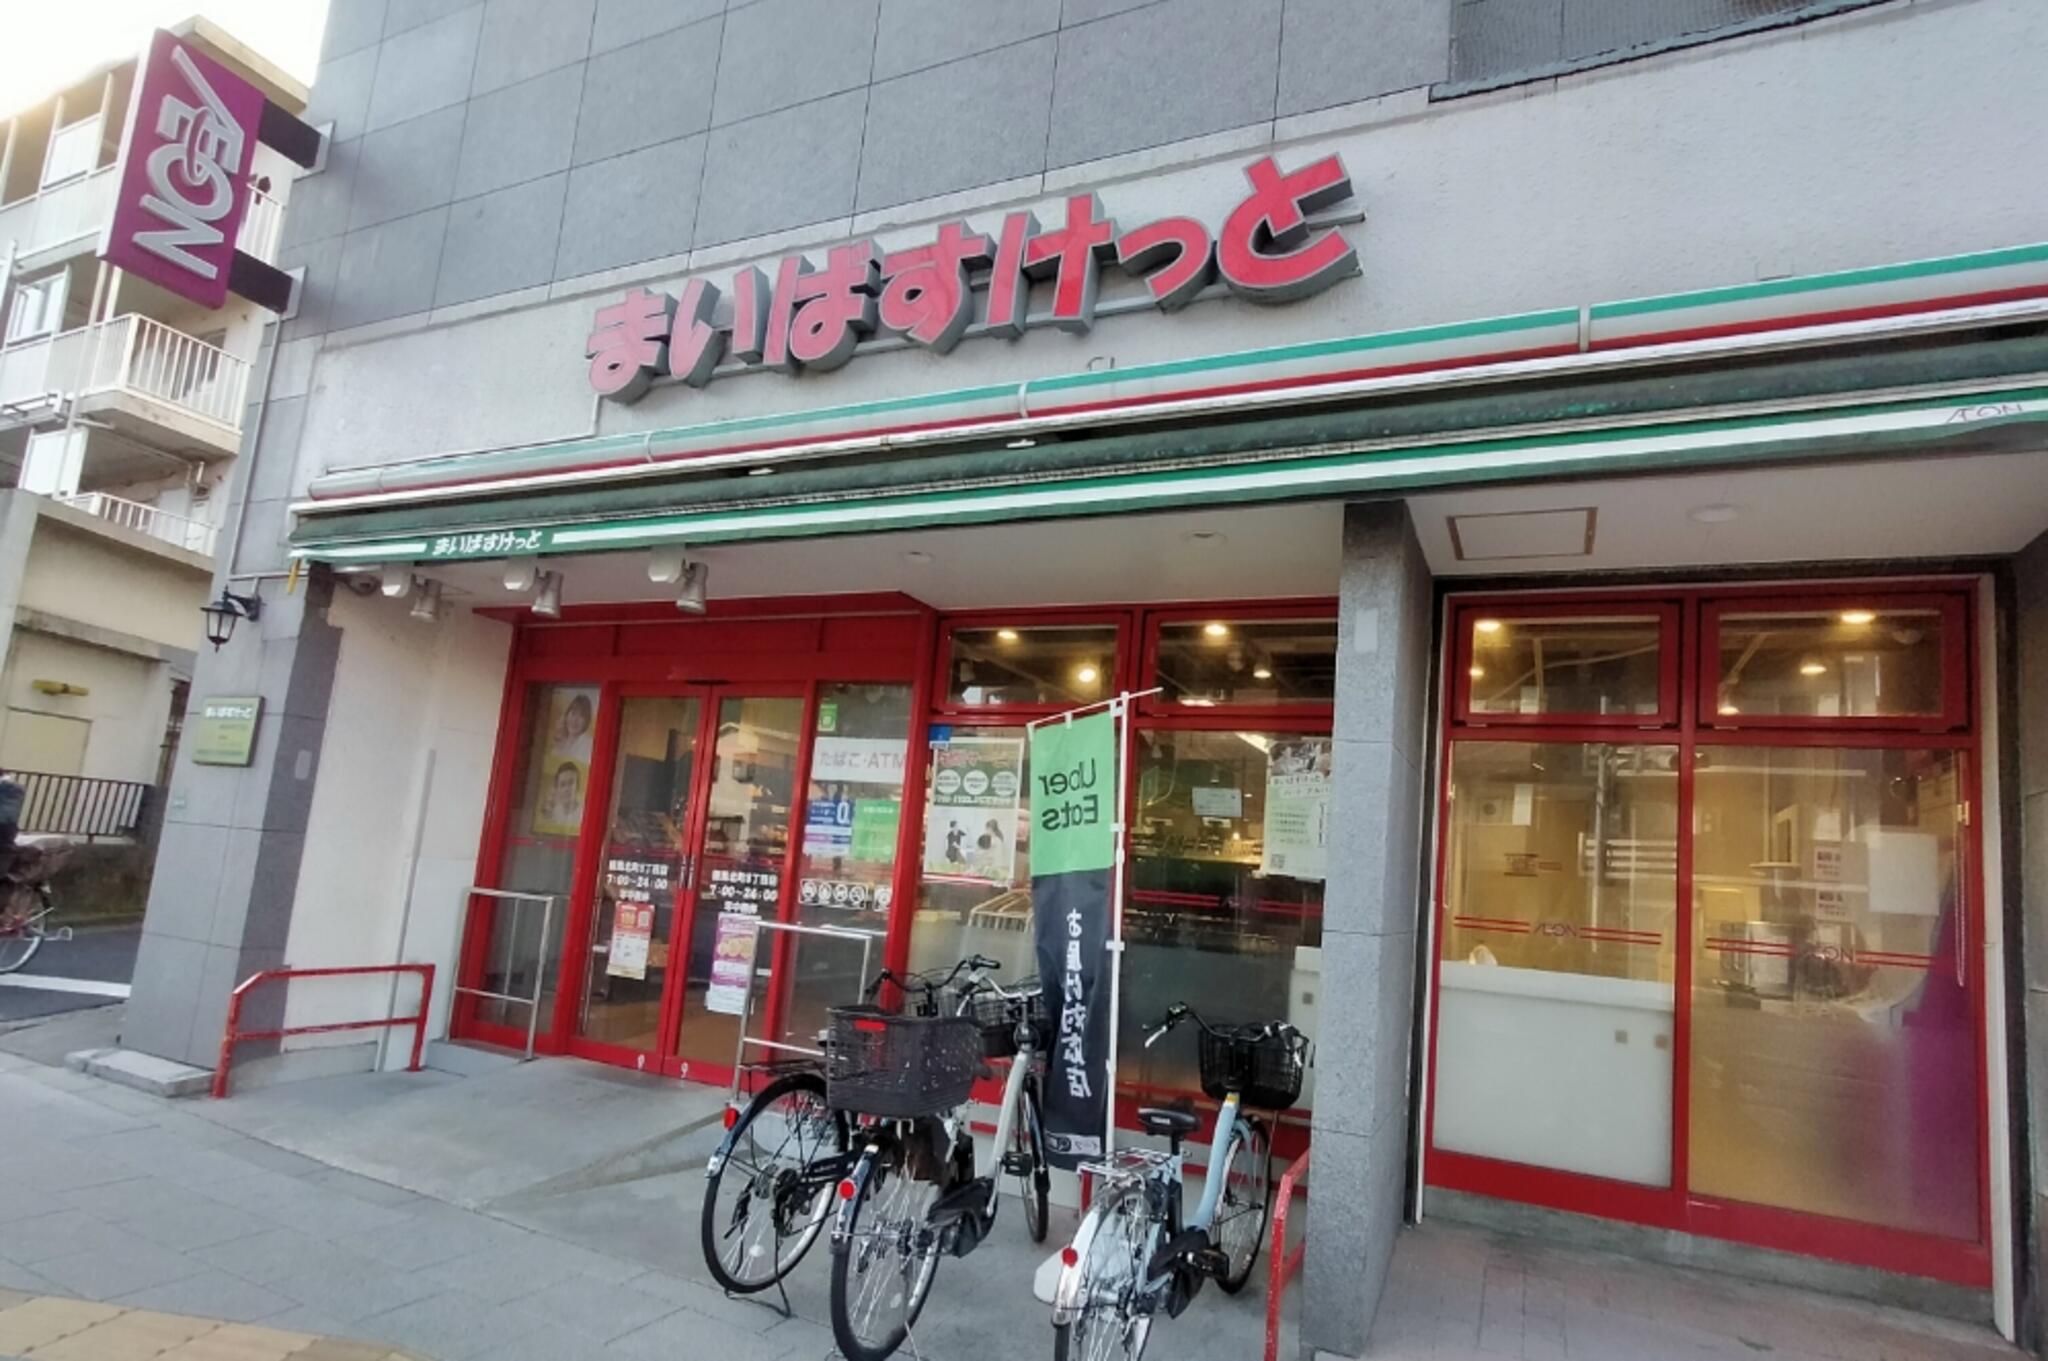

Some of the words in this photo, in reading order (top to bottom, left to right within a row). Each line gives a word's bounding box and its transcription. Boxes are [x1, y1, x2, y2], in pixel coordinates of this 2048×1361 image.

[586, 151, 1358, 402] まいばすけっと
[432, 529, 543, 556] まいばすけっと
